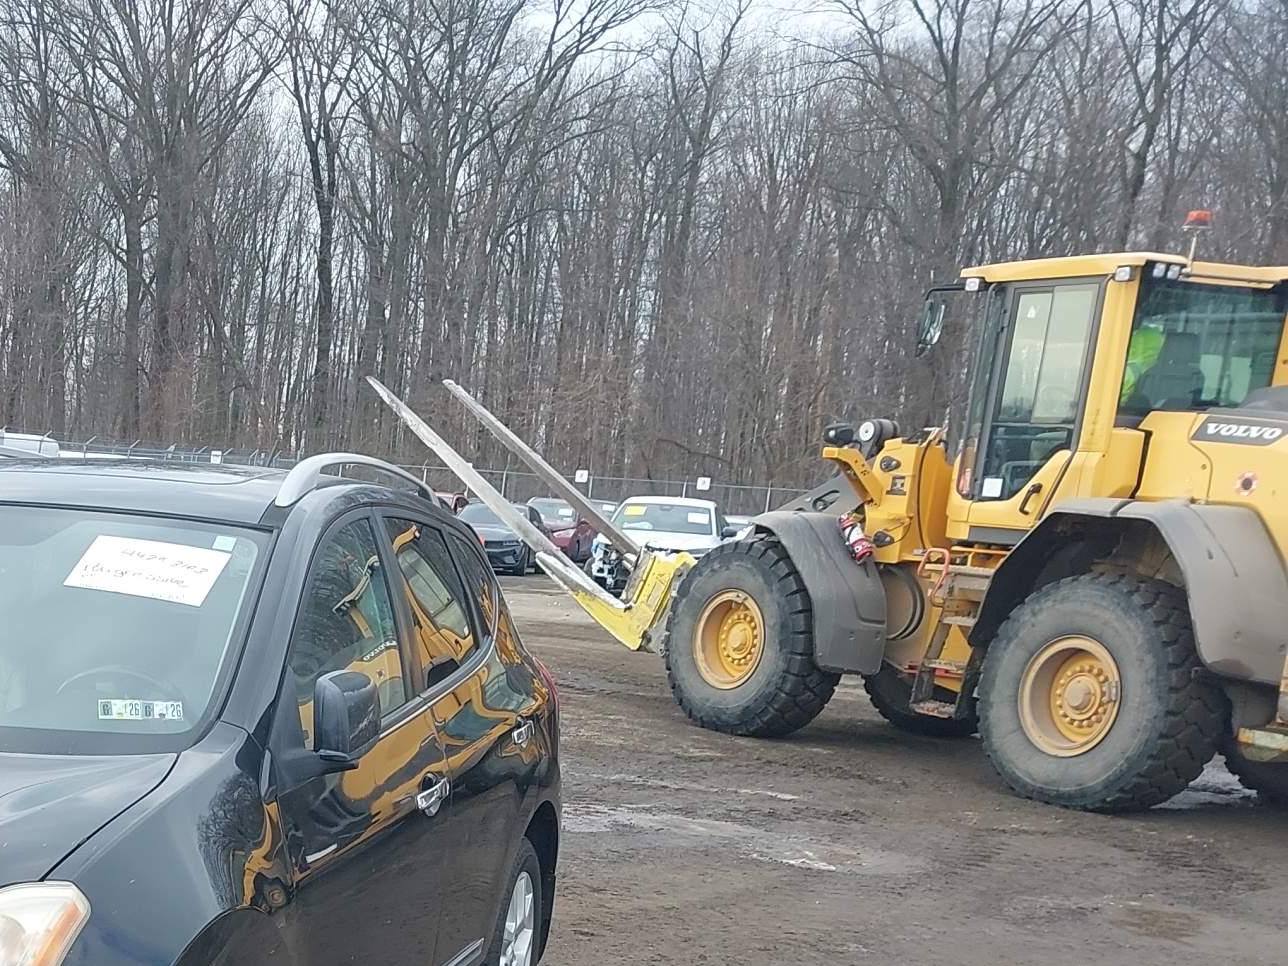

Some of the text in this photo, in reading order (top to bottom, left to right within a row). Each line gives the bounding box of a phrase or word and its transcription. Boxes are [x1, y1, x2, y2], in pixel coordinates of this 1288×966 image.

[1207, 422, 1283, 440] VOLVO
[128, 702, 140, 716] 26
[170, 703, 182, 718] 26
